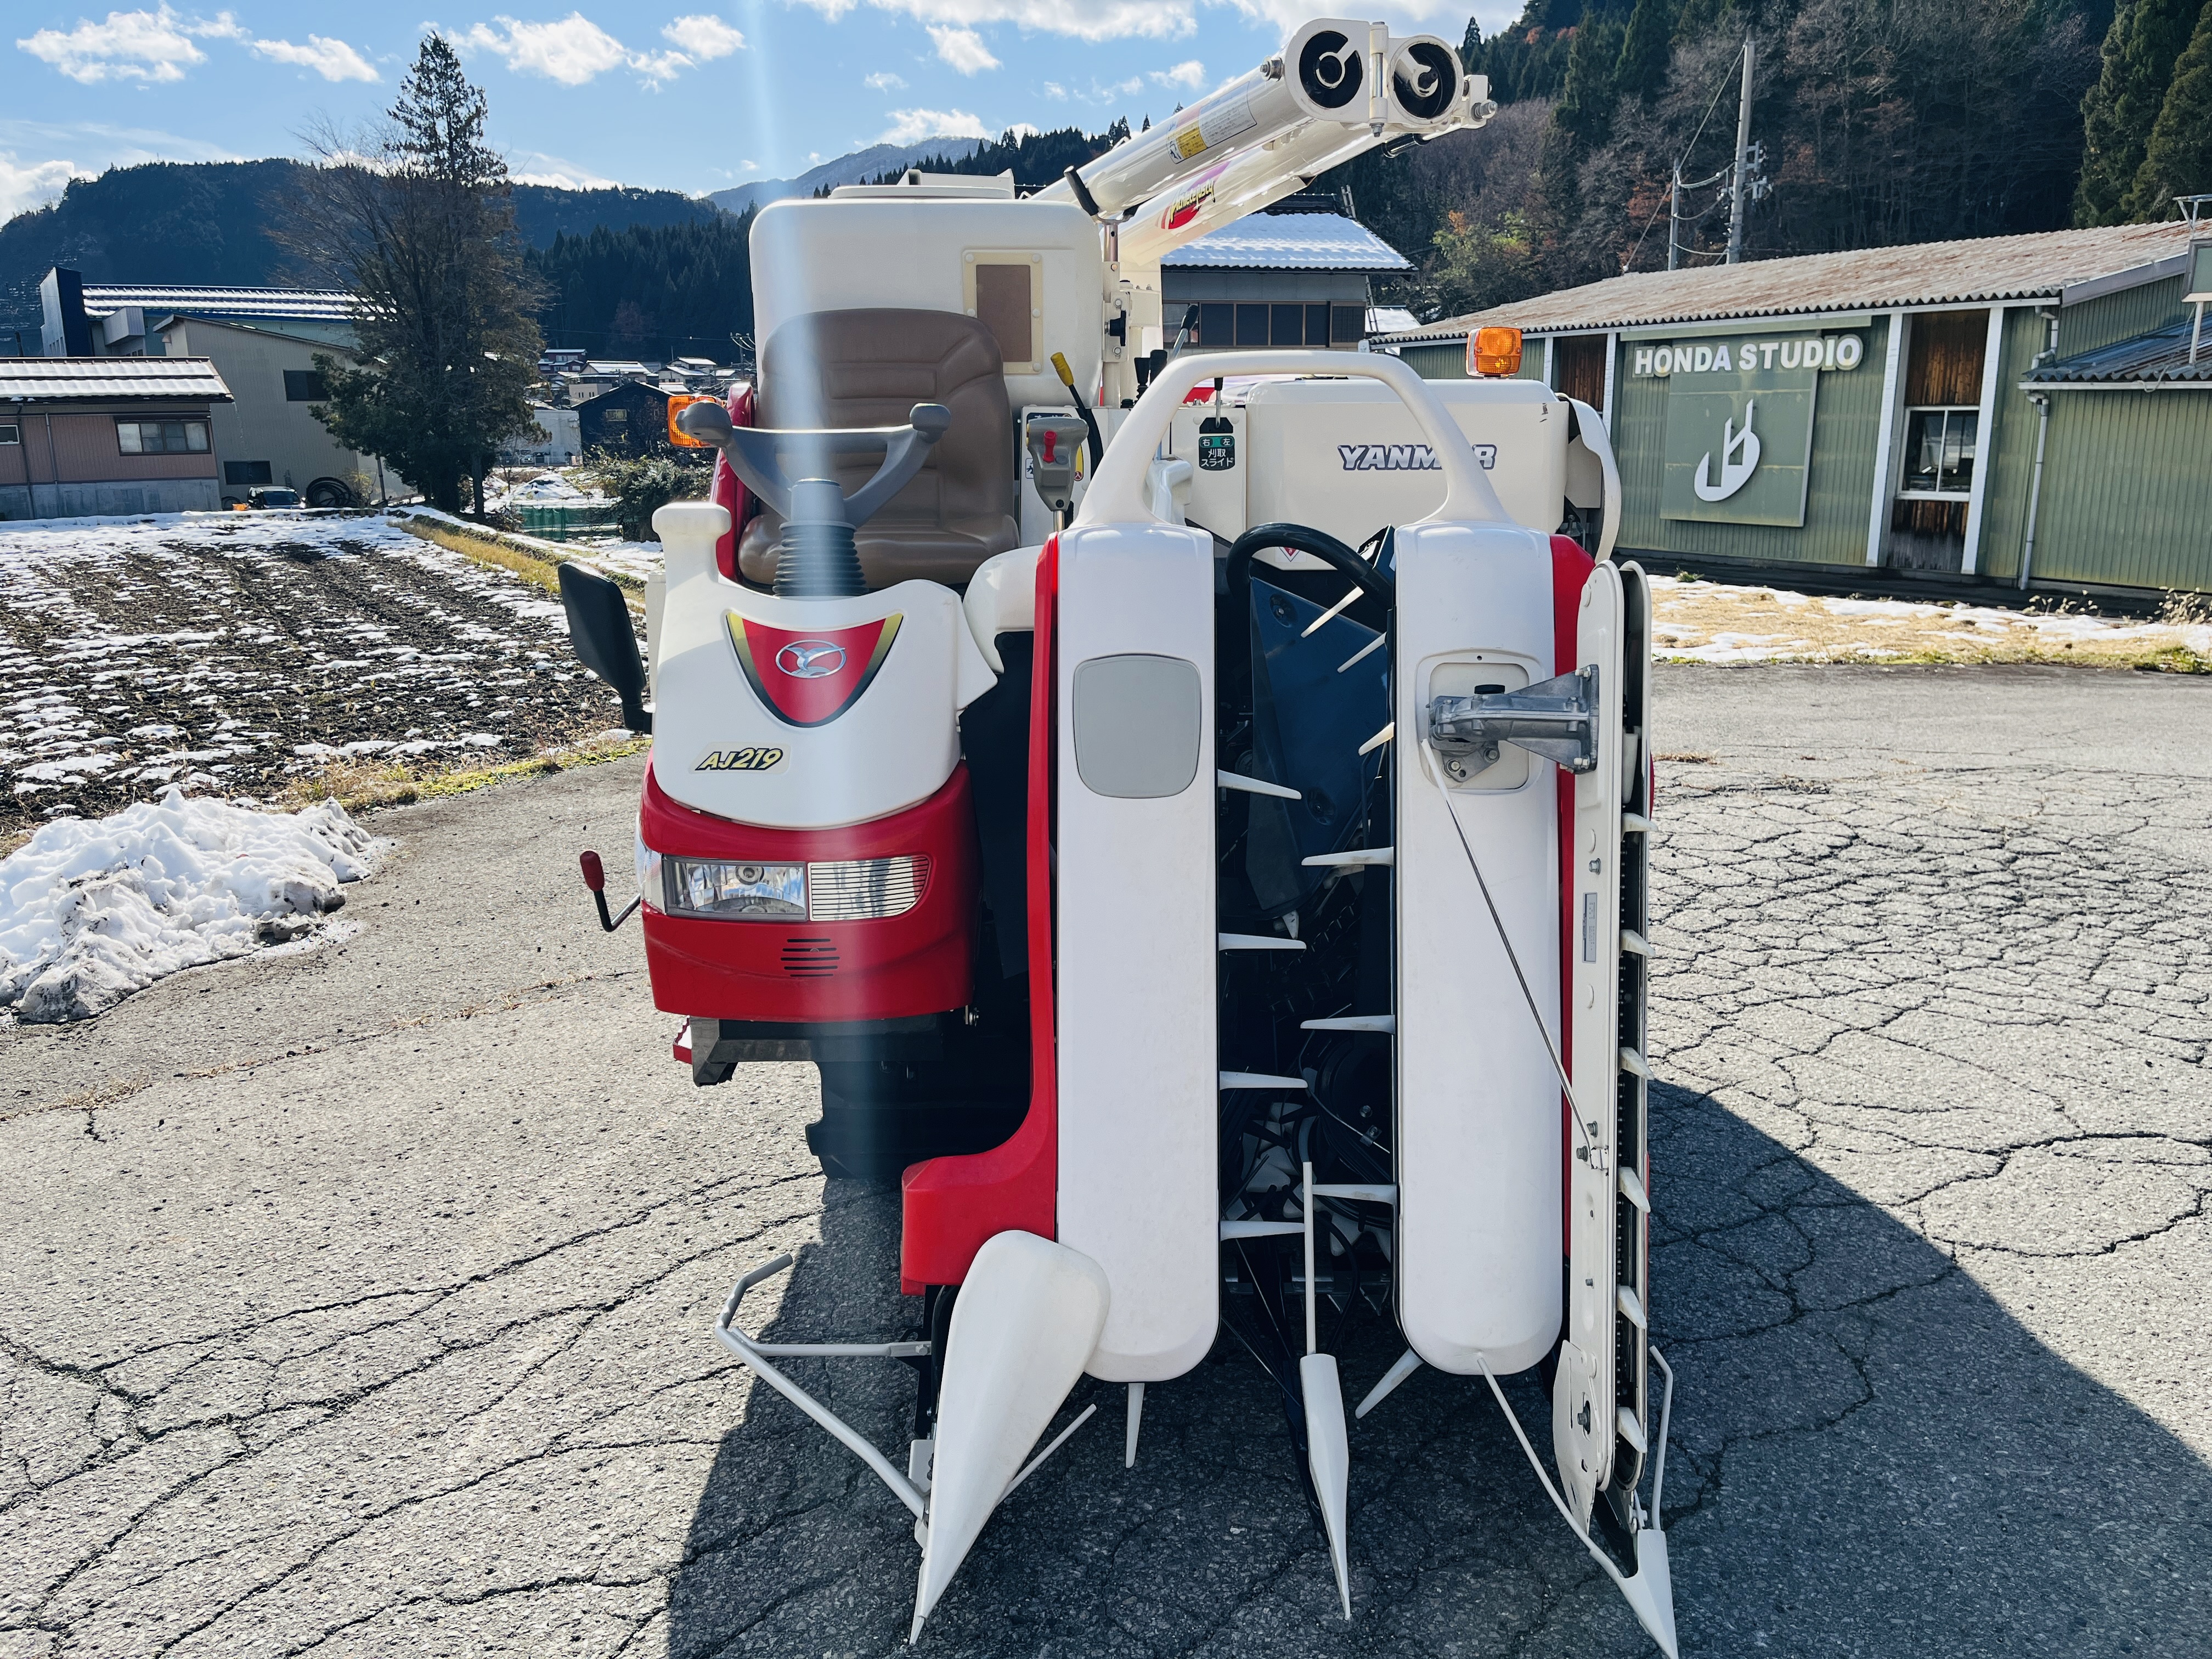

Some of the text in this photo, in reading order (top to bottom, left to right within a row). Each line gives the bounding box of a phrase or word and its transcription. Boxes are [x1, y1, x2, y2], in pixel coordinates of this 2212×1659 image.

[1635, 337, 1860, 375] HONDA STUDIO
[1201, 458, 1233, 467] スライド
[1208, 449, 1226, 458] 刈取
[1338, 444, 1497, 470] YANMR
[695, 748, 783, 770] AJ219
